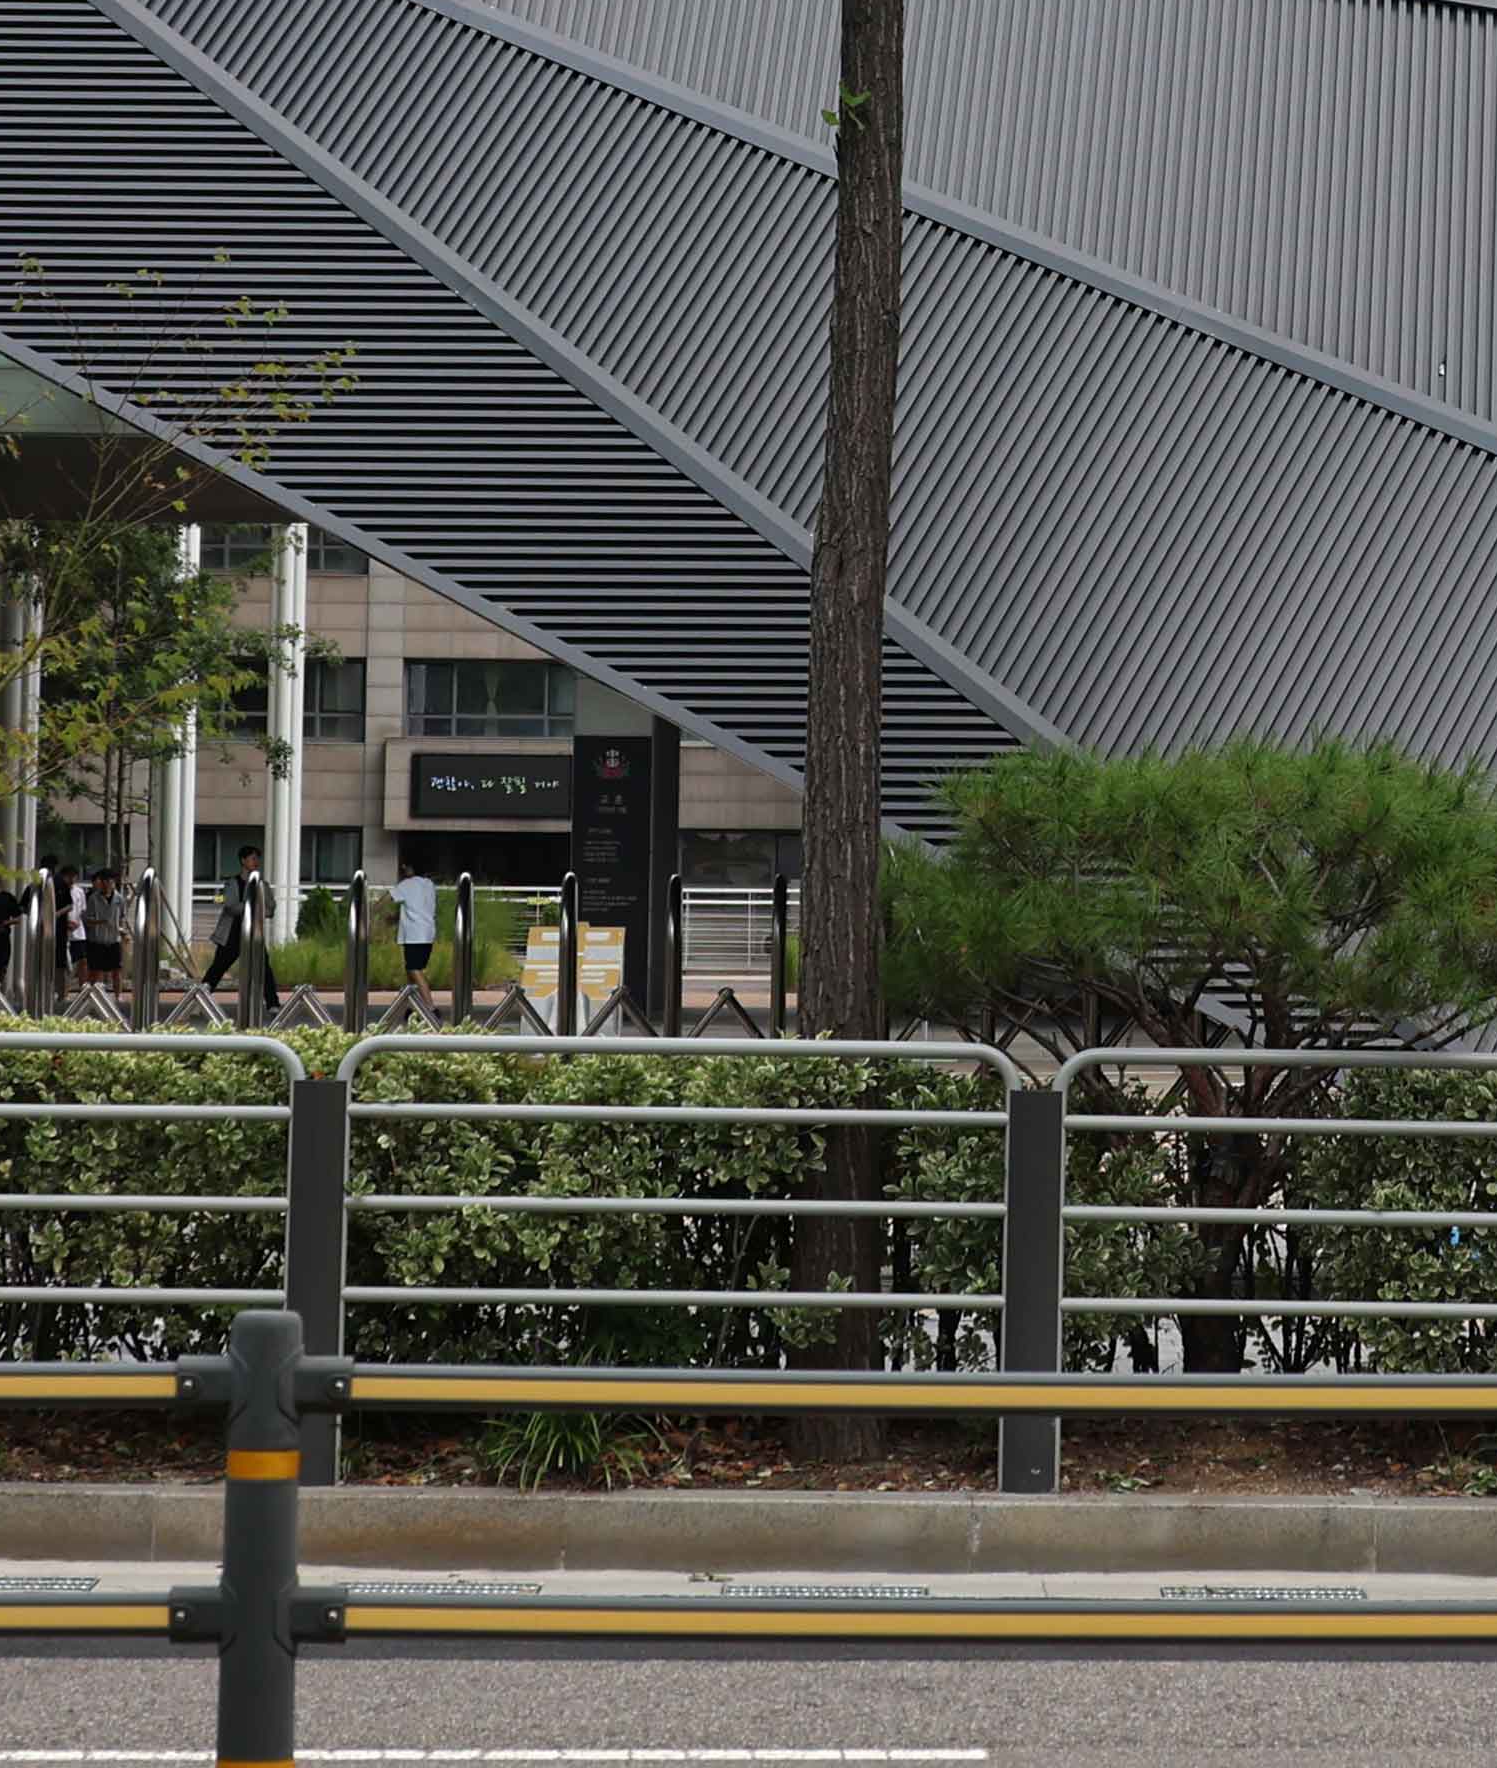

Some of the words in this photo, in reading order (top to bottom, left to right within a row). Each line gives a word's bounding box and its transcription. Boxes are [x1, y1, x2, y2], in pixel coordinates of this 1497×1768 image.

[430, 775, 476, 792] 괜찮아,
[500, 775, 527, 795] 잘될
[534, 779, 560, 789] 거야
